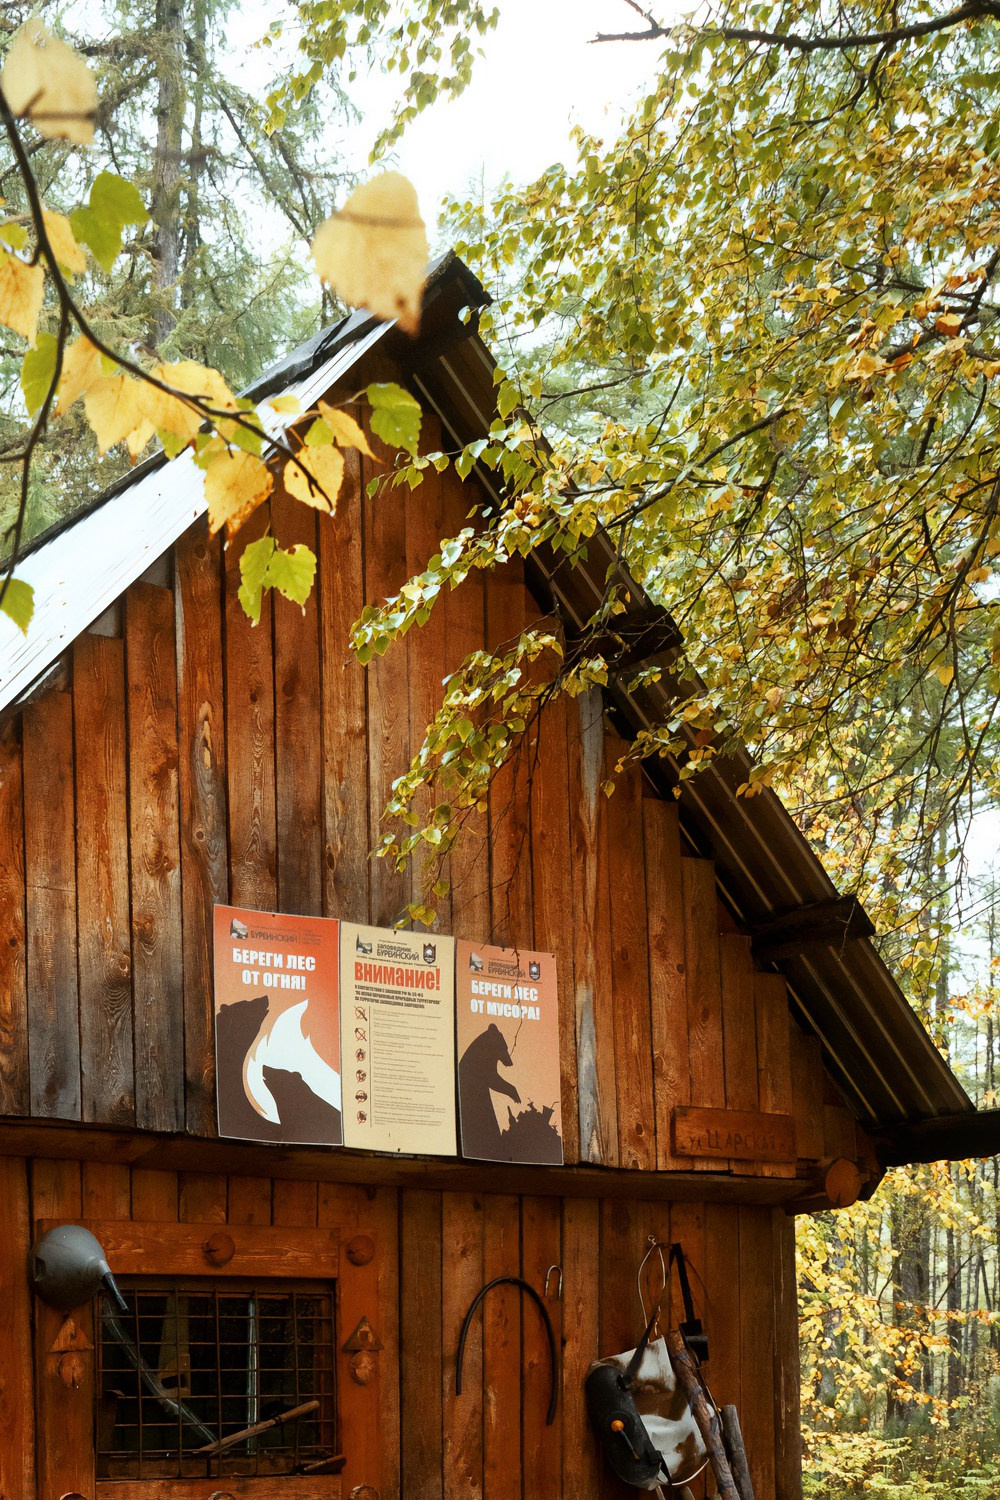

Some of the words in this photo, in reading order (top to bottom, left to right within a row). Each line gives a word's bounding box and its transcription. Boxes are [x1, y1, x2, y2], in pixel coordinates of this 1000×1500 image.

[232, 947, 283, 968] БЕРЕГИ
[286, 954, 316, 971] ЛЕС
[242, 969, 260, 986] ОТ
[263, 972, 306, 990] ОГНЯ!
[471, 980, 512, 999] БЕРЕГИ
[514, 986, 539, 1002] ЛЕС
[470, 999, 485, 1014] ОТ
[487, 1001, 540, 1020] МУСОРА!
